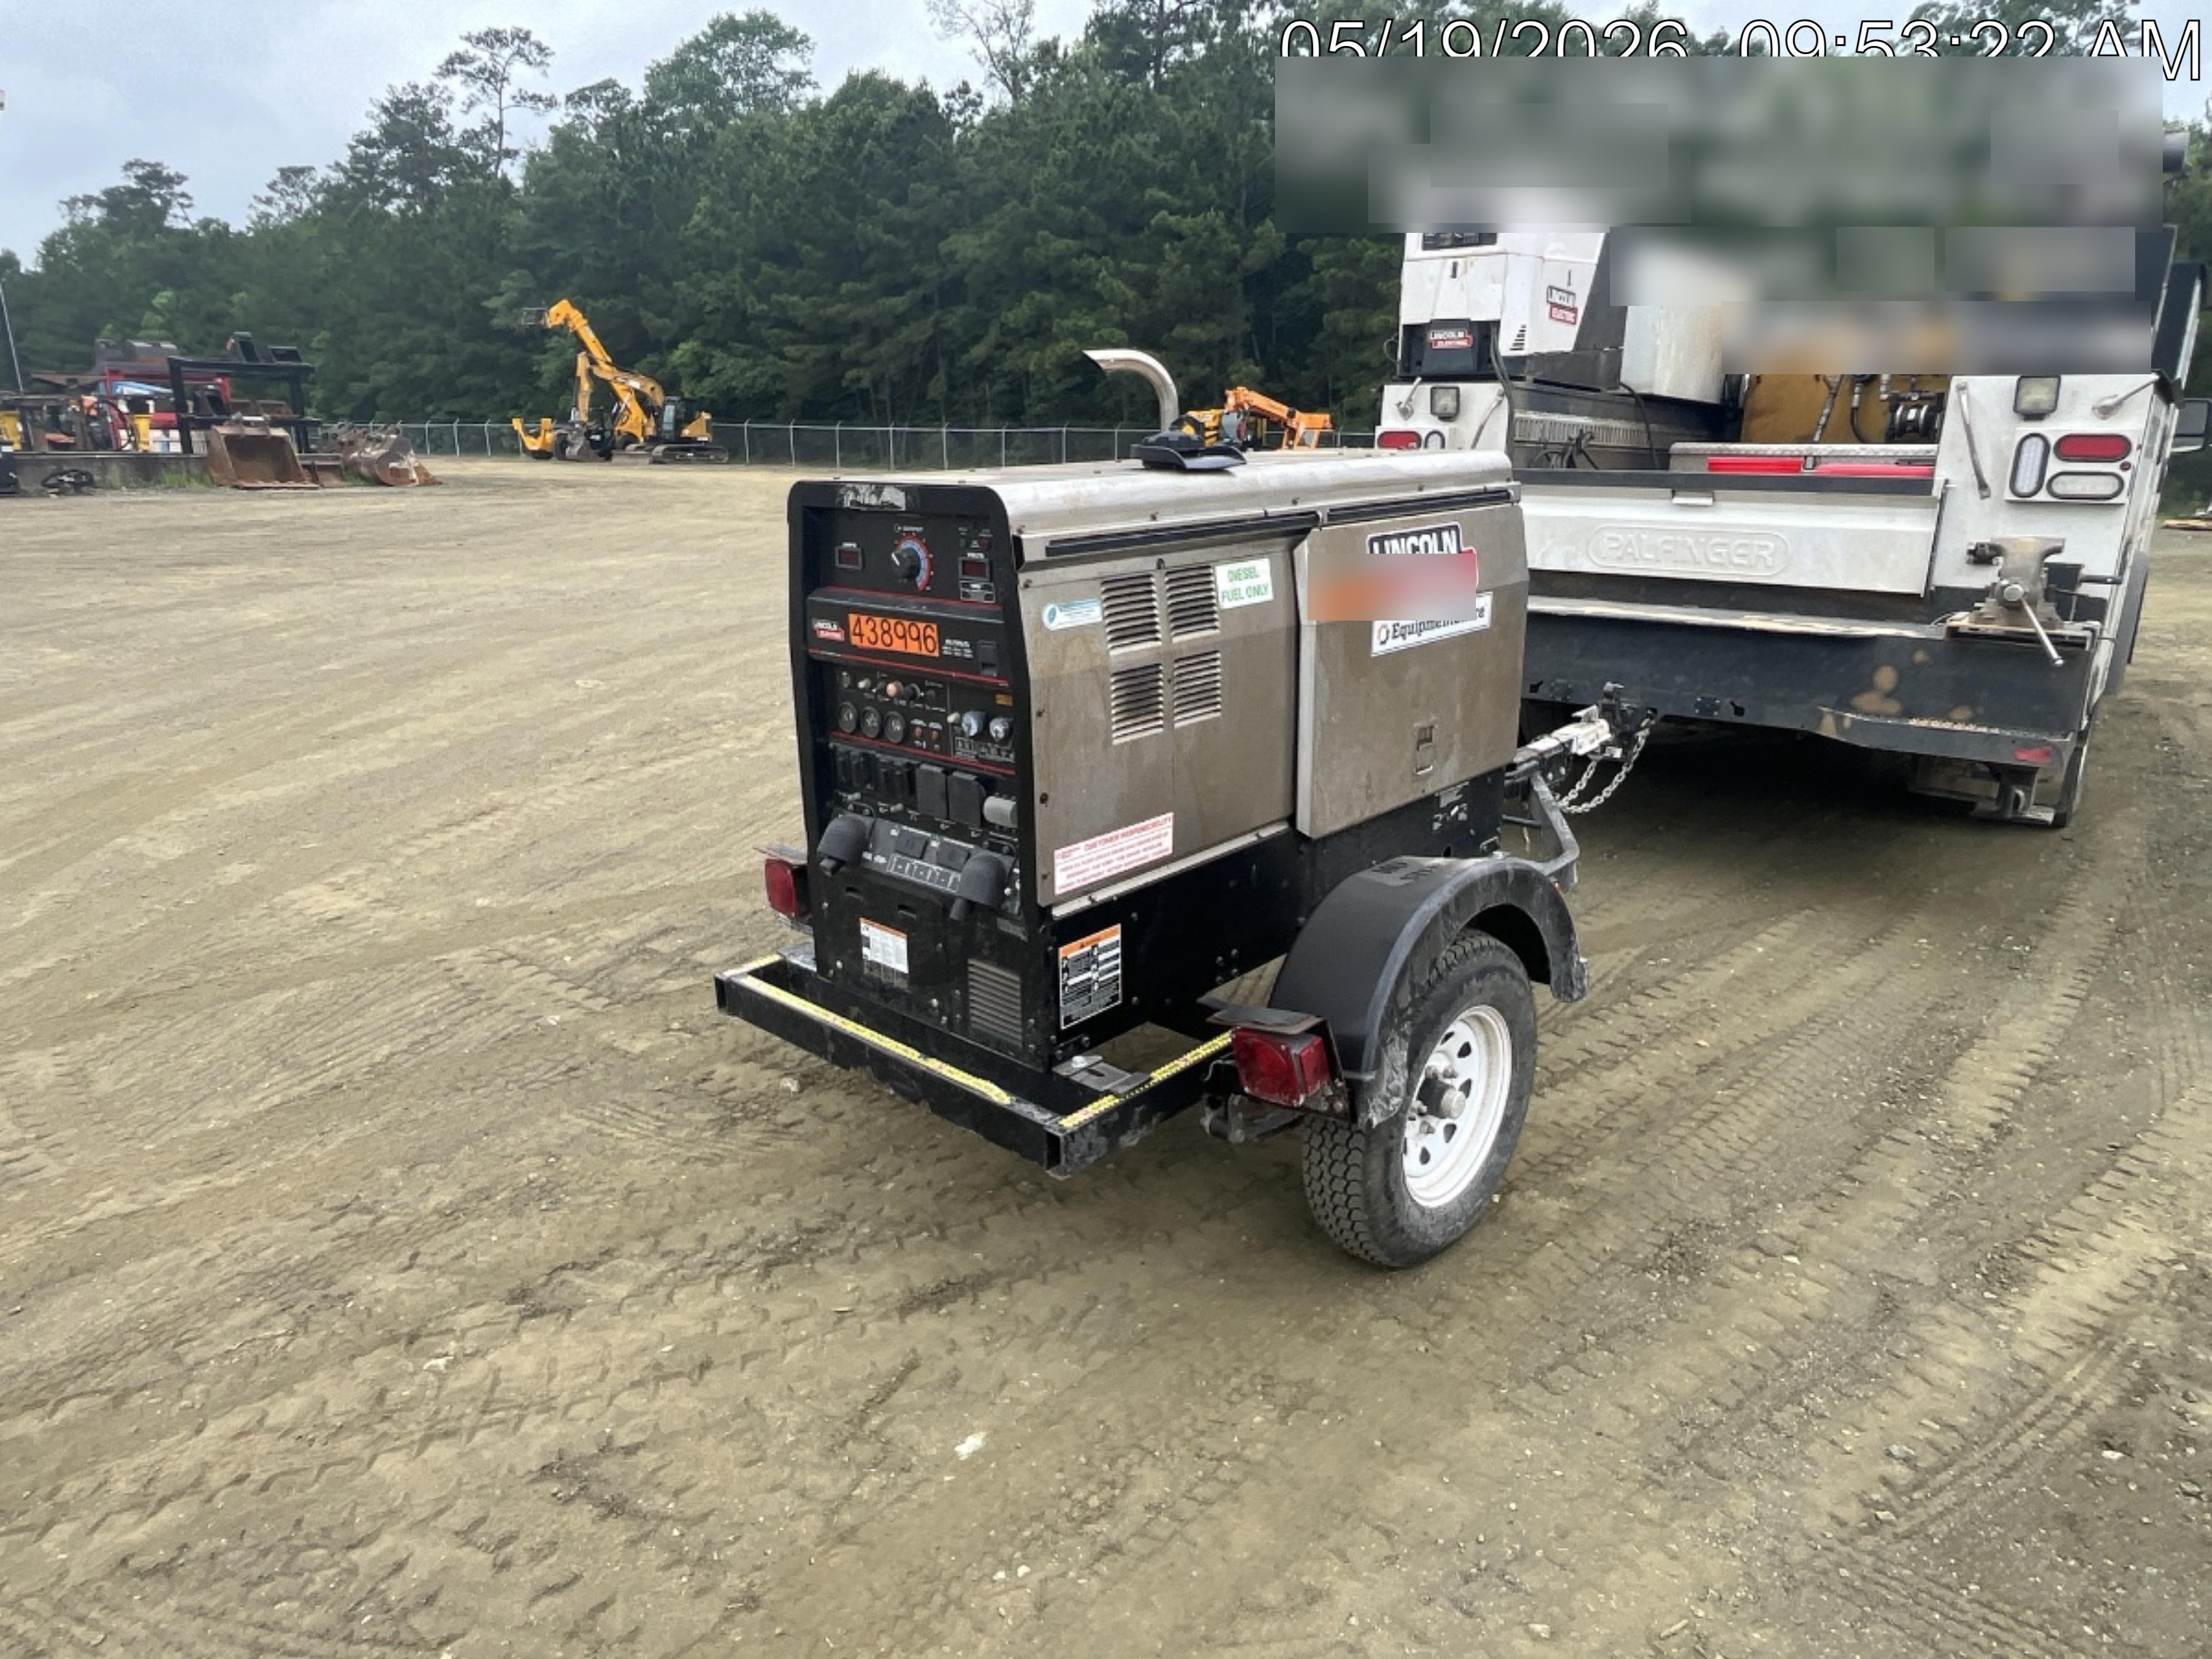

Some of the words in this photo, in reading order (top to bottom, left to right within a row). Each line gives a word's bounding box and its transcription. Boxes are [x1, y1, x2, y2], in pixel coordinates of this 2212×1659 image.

[1600, 532, 1775, 568] PALFINGER
[1228, 566, 1260, 582] DIESEL
[1221, 587, 1245, 603] FUEL
[1245, 582, 1269, 598] ONLY
[852, 616, 938, 653] 438996
